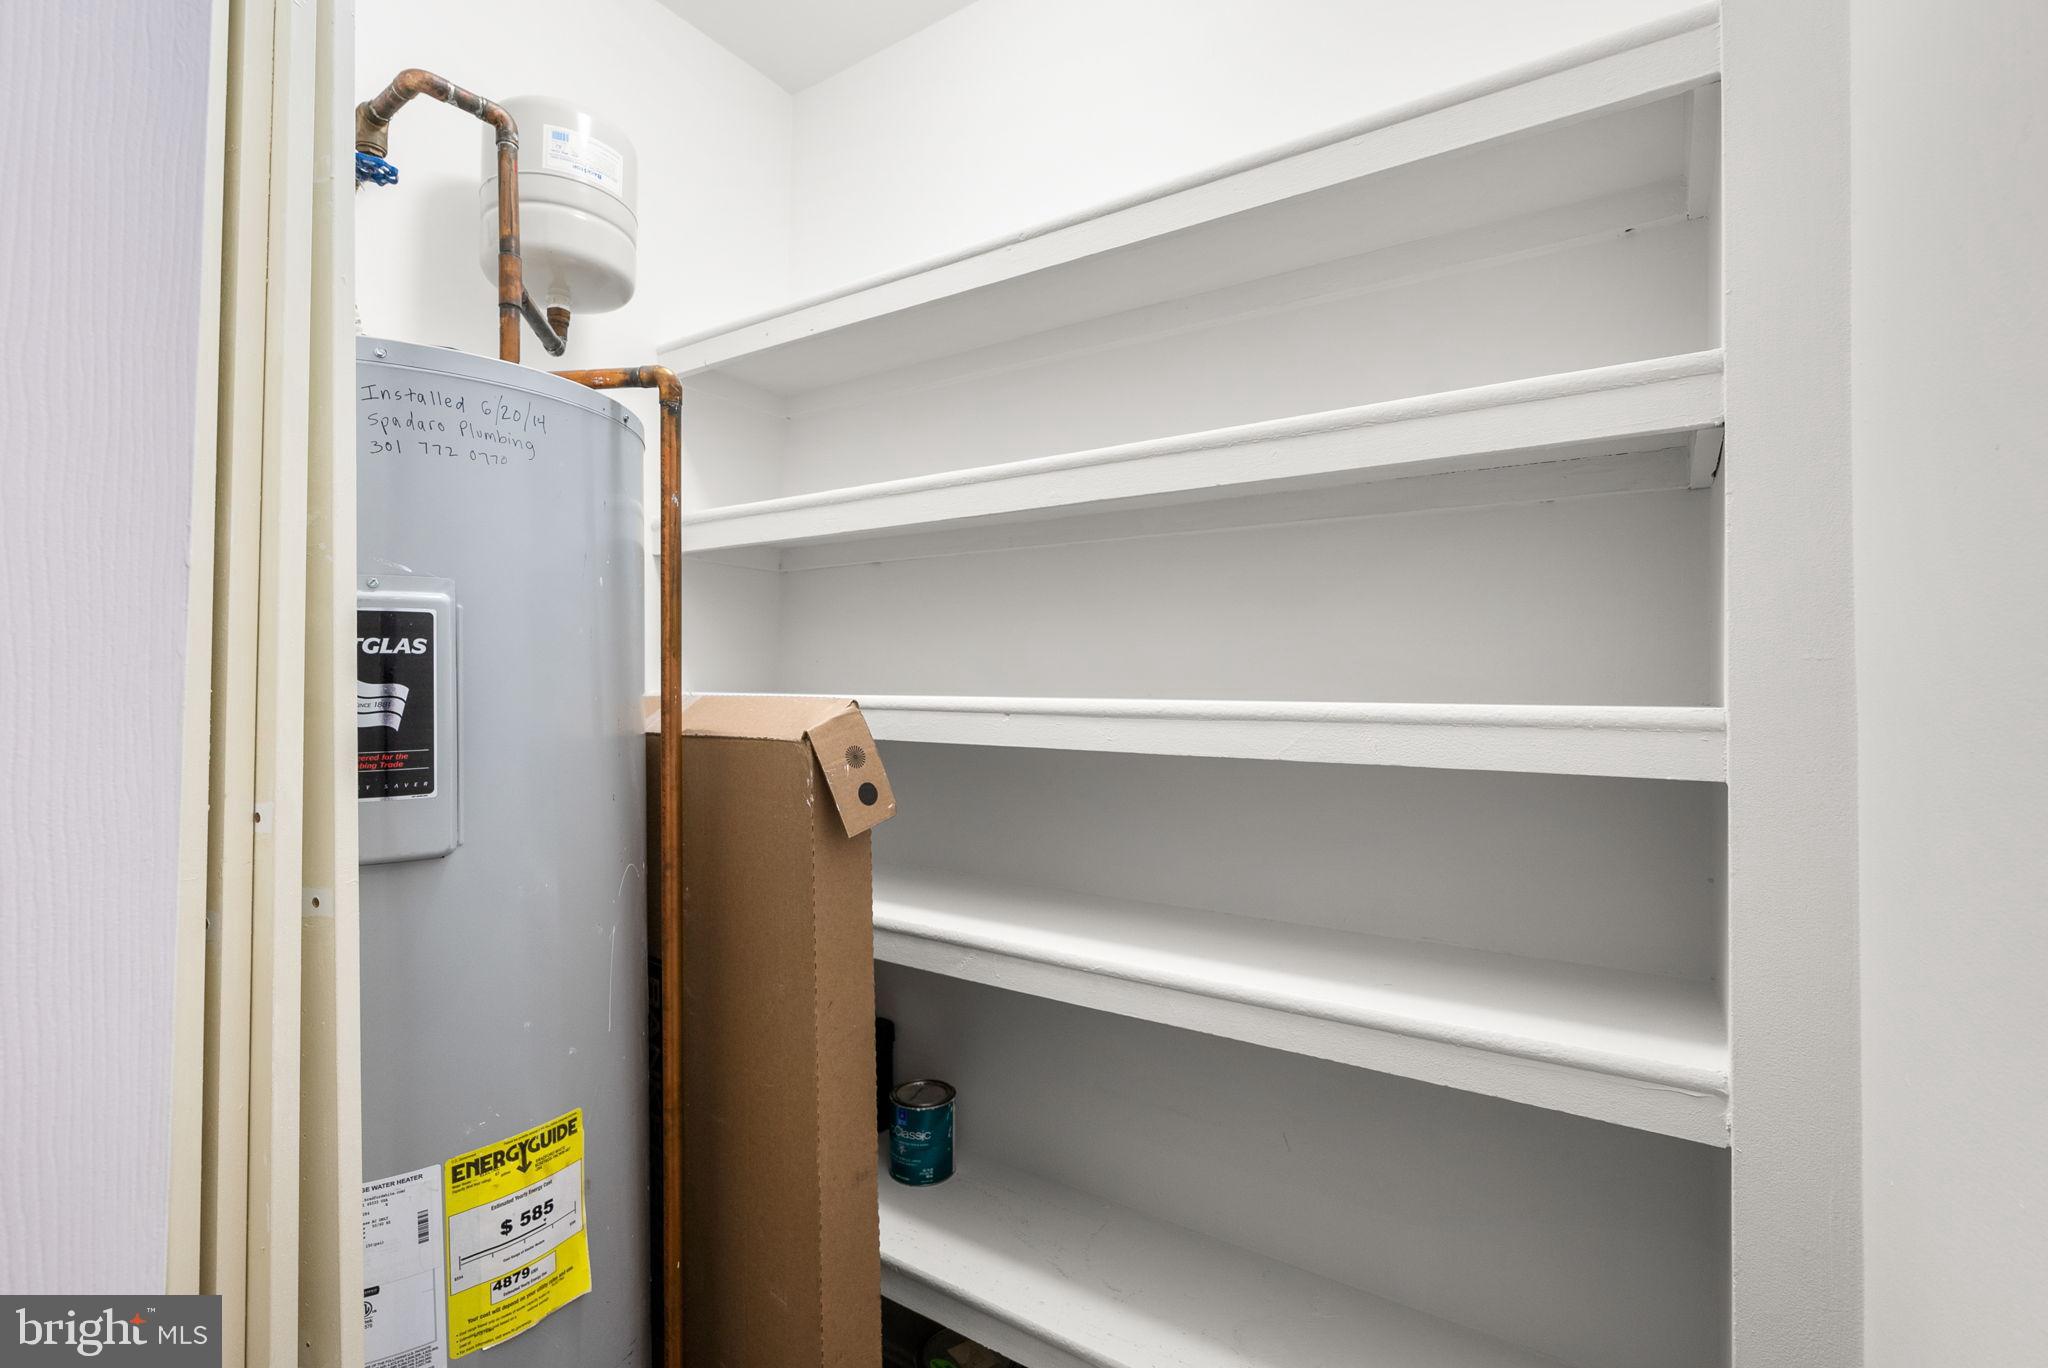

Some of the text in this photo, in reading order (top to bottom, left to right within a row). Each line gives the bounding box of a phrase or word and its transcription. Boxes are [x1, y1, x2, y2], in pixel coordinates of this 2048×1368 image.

[361, 384, 547, 434] Installed 6/20/14
[368, 412, 536, 460] Spadaro Plumbing
[370, 440, 507, 465] 301 772 0770
[358, 752, 409, 762] ered for the
[380, 761, 405, 769] Trade
[384, 781, 429, 790] SAVER
[451, 1117, 578, 1185] ENERGYGUIDE
[371, 1180, 396, 1191] WATER
[396, 1174, 424, 1186] HEATER
[490, 1197, 515, 1211] Estimated
[500, 1198, 554, 1236] $ 585
[492, 1266, 531, 1291] 4879
